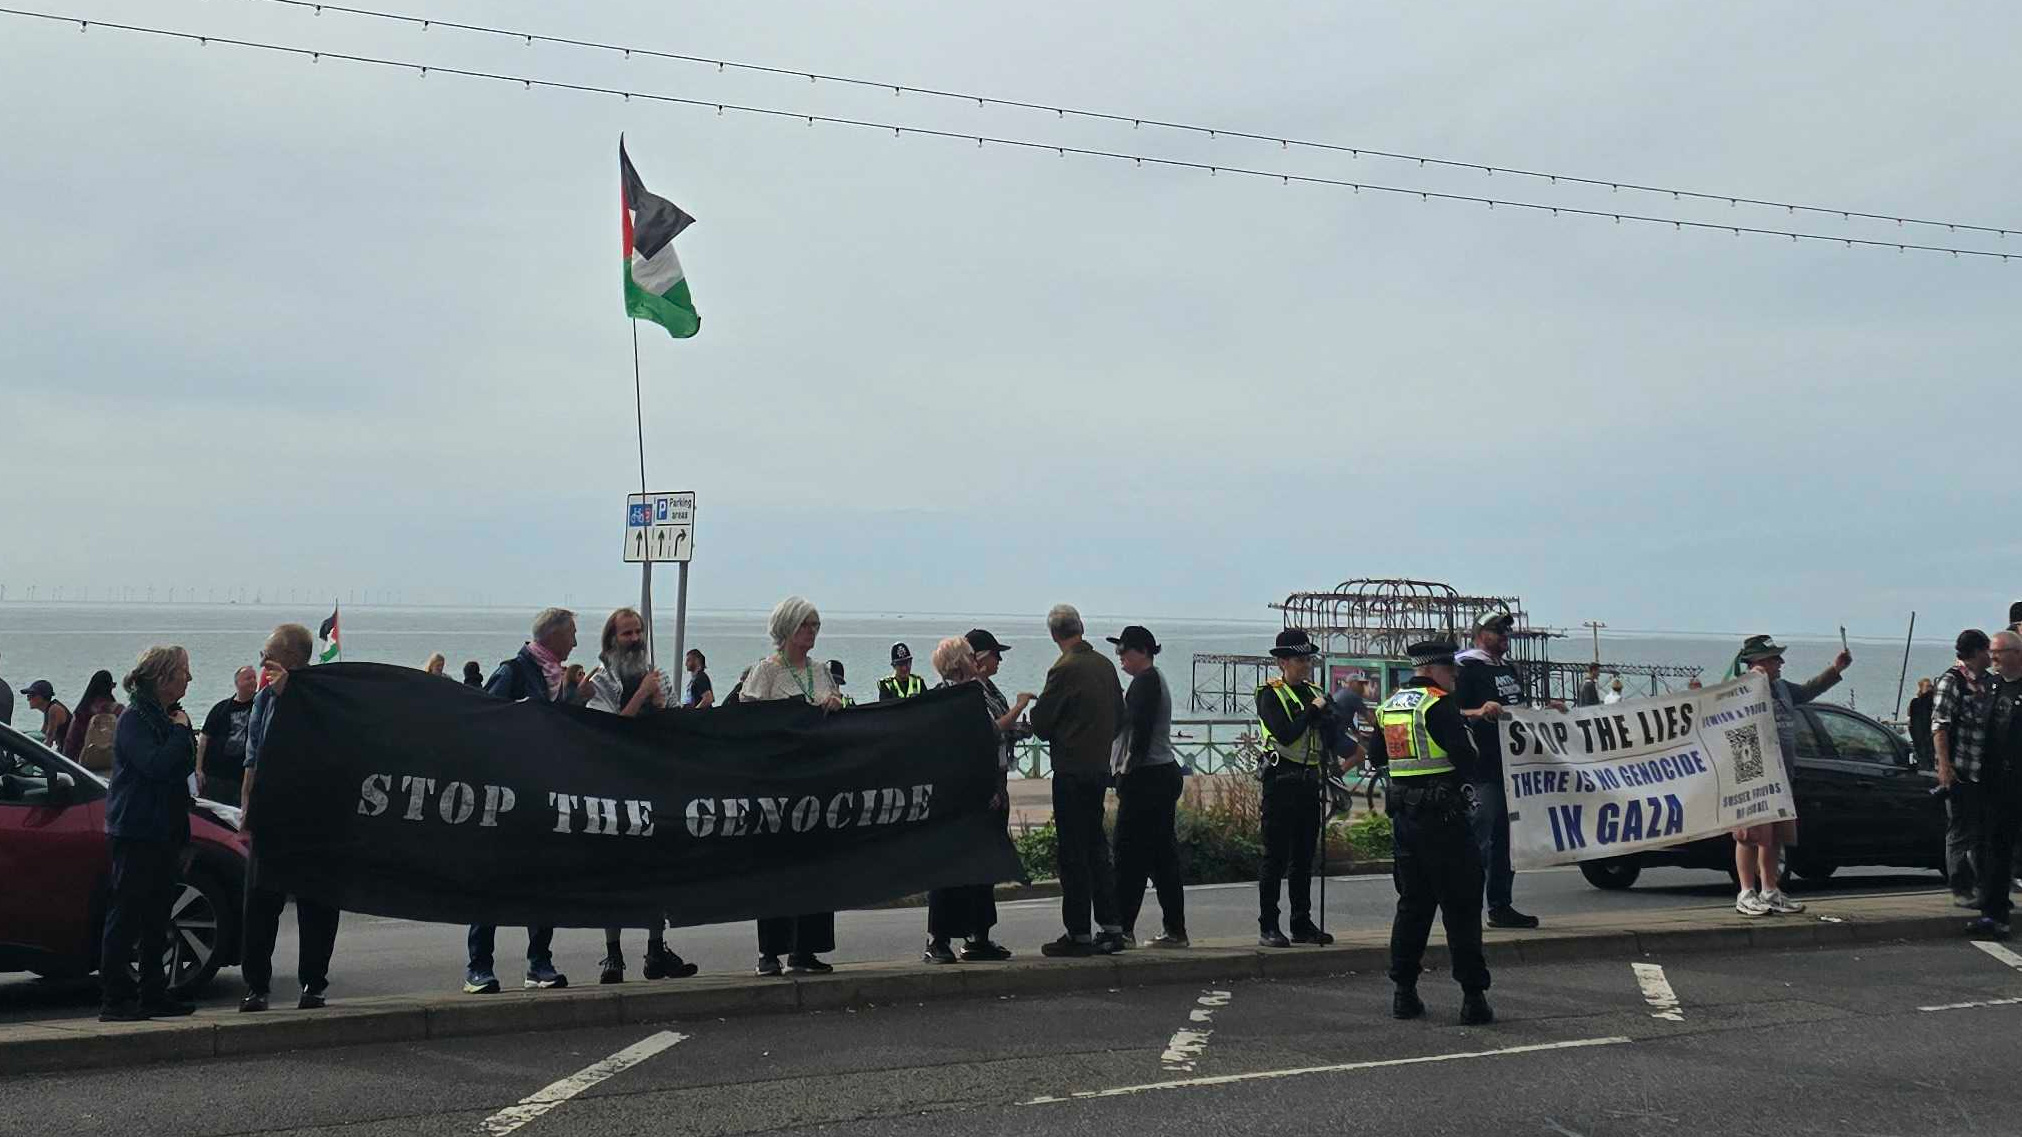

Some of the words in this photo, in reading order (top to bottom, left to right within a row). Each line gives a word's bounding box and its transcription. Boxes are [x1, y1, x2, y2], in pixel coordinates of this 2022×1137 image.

[669, 498, 692, 508] Parking
[671, 511, 688, 520] areas
[1509, 720, 1568, 756] STOP
[1575, 715, 1633, 754] THE
[1637, 703, 1693, 745] LIES
[1511, 770, 1570, 799] THERE
[1575, 770, 1596, 793] IS
[1593, 767, 1620, 791] NO
[1618, 750, 1707, 787] GENOCIDE
[357, 773, 515, 827] STOP
[549, 791, 655, 836] THE
[685, 784, 934, 837] GENOCIDE
[1548, 804, 1587, 852] IN
[1596, 793, 1684, 846] GAZA
